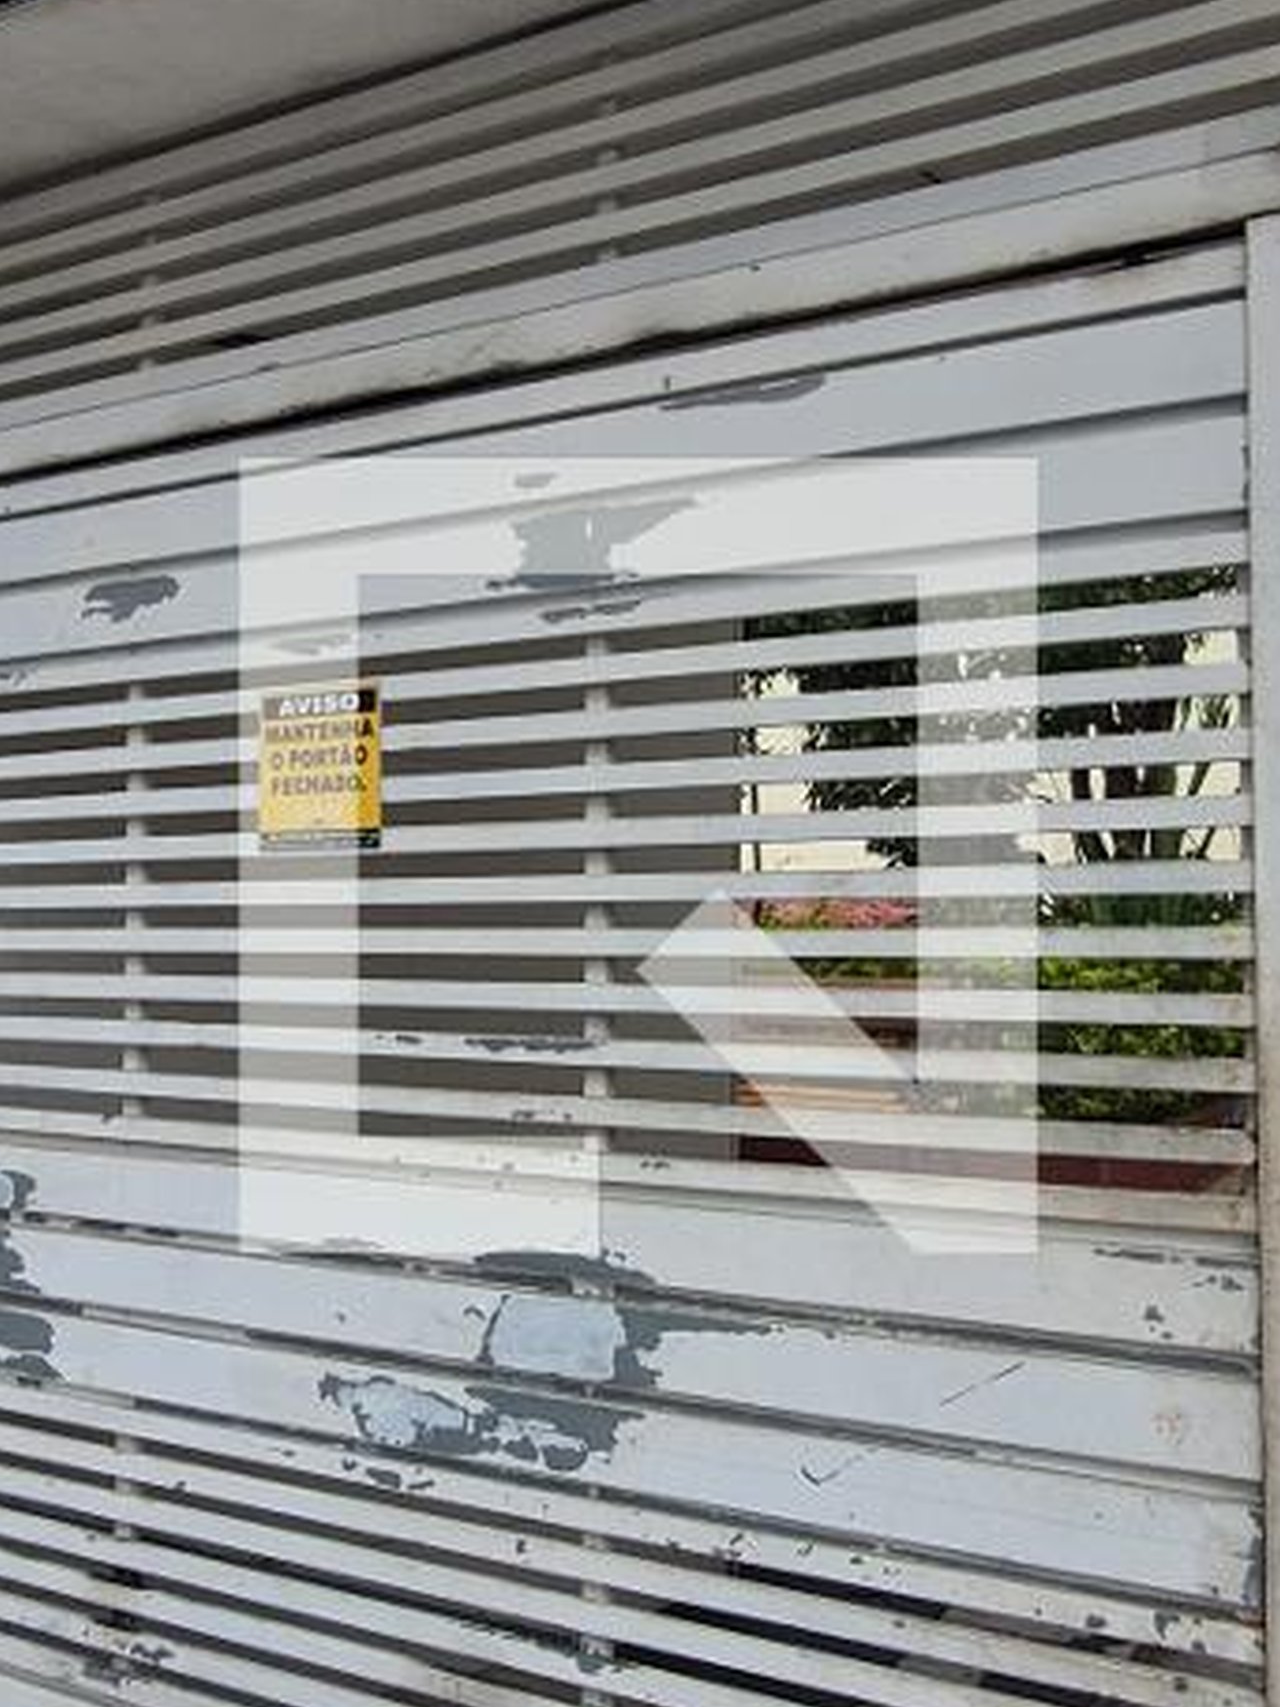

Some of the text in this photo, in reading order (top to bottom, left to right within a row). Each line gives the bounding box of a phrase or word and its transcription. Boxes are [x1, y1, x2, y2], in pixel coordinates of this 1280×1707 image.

[279, 694, 360, 716] AVISO
[272, 744, 368, 770] O PORTÃO
